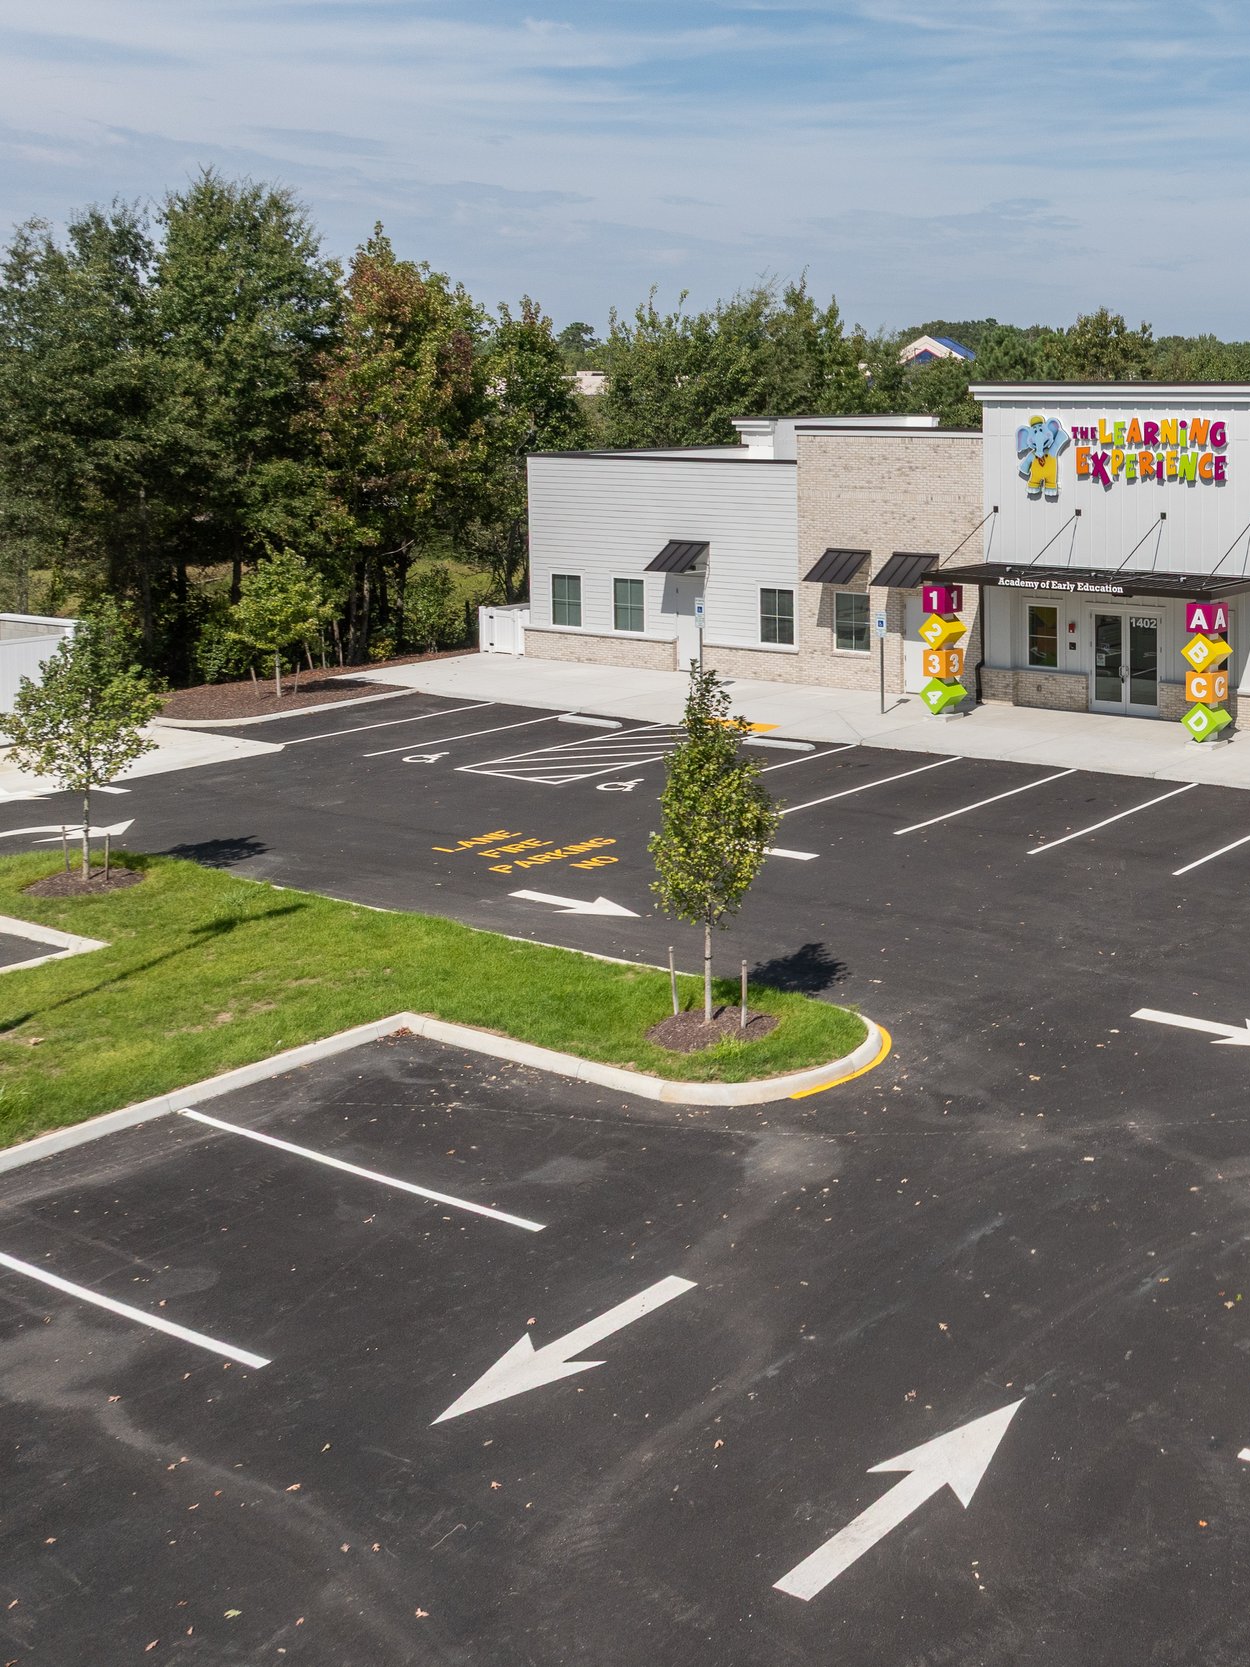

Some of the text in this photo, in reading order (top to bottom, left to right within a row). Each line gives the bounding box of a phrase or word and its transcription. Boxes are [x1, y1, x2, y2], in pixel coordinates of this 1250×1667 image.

[1071, 426, 1097, 440] THE
[998, 577, 1124, 594] Academy of Early Education
[929, 590, 938, 610] 1
[951, 590, 958, 610] 1
[1130, 617, 1157, 629] 1402
[1189, 608, 1209, 630] A
[1214, 608, 1227, 630] A
[924, 623, 942, 643] 2
[1187, 640, 1209, 664] B
[928, 654, 940, 674] 3
[949, 653, 959, 673] 3
[1190, 677, 1207, 698] C
[1214, 676, 1225, 697] C
[926, 690, 943, 705] 4
[1187, 709, 1208, 732] D
[432, 829, 523, 853] LANE
[477, 837, 554, 859] FIRE
[488, 837, 617, 874] PARKING
[569, 855, 619, 870] NO
